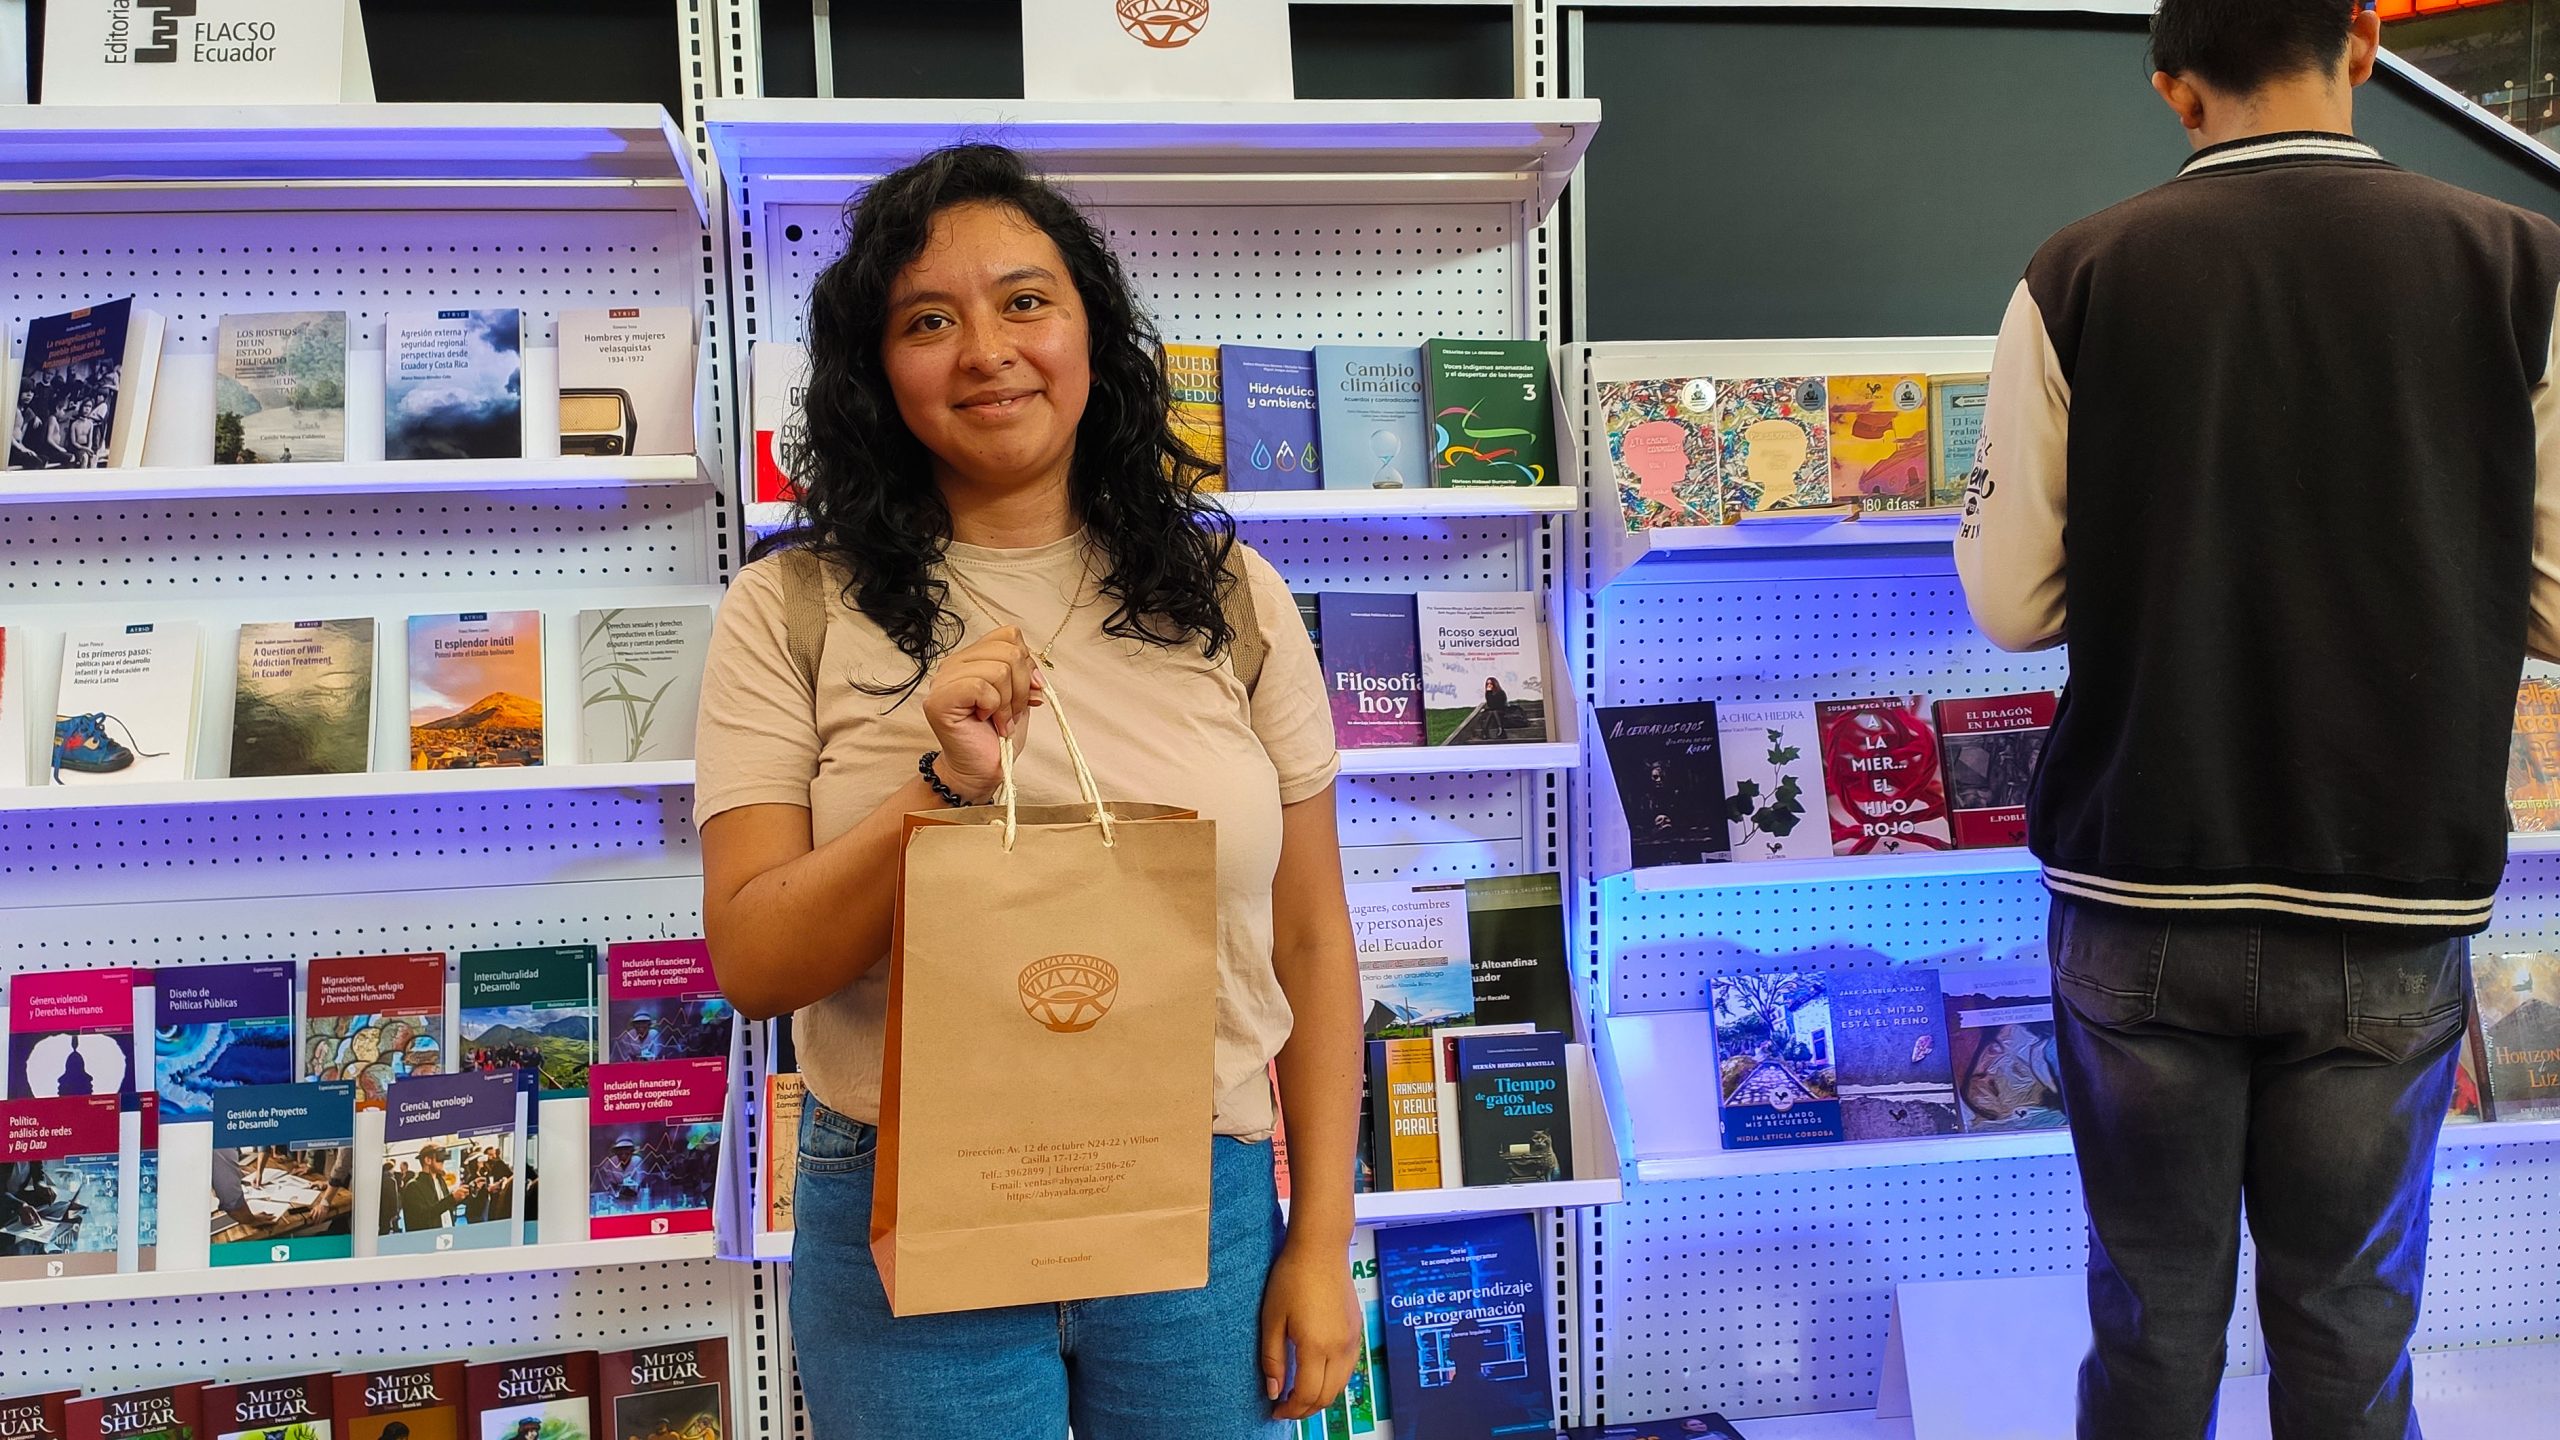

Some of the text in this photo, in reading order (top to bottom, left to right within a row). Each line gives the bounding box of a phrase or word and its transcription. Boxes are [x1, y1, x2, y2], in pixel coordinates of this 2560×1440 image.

[195, 22, 276, 42] FLACSO
[194, 42, 276, 63] Ecuador
[236, 328, 298, 339] LOS ROSTROS
[584, 331, 666, 344] Hombres y mujeres
[236, 339, 265, 348] DE UN
[401, 339, 436, 350] seguridad
[599, 343, 652, 355] velasquistas
[236, 348, 272, 357] ESTADO
[400, 349, 468, 361] perspectivas desde
[235, 357, 287, 367] DELEGADO
[400, 360, 469, 372] Ecuador y Costa Rica
[1345, 361, 1415, 377] Cambio
[1249, 382, 1316, 396] Hidráulica
[1340, 377, 1422, 393] climático
[1522, 383, 1537, 401] 3
[1862, 497, 1921, 512] 180 días:
[606, 621, 631, 630] Derechos
[631, 620, 654, 629] sexuales
[659, 620, 683, 628] derechos
[1438, 626, 1518, 638] Acoso sexual
[434, 635, 514, 651] El esplendor inútil
[1438, 636, 1520, 650] y universidad
[77, 648, 152, 661] Los primeros pasos:
[252, 656, 332, 668] Addiction Treatment
[73, 676, 119, 686] América Latina
[1357, 689, 1409, 719] hoy
[1966, 706, 2034, 720] EL DRAGÓN
[1867, 714, 1880, 729] A
[1967, 716, 2034, 731] EN LA FLOR
[1609, 720, 1705, 740] AL CERRAR LOS OJOS
[1864, 735, 1888, 750] LA
[1851, 756, 1908, 772] MIER...
[1872, 778, 1893, 793] EL
[1864, 799, 1907, 816] HILO
[1355, 914, 1444, 936] y personajes
[1358, 935, 1445, 953] del Ecuador
[473, 968, 540, 982] Interculturalidad
[621, 965, 705, 980] gestión de cooperativas
[321, 975, 366, 987] Migraciones
[321, 981, 404, 995] internacionales, refugio
[473, 981, 521, 995] y Desarrollo
[29, 993, 88, 1007] Género, violencia
[169, 987, 210, 999] Diseño de
[169, 998, 238, 1011] Políticas Públicas
[1847, 1004, 1925, 1018] EN LA MITAD
[1840, 1015, 1930, 1029] ESTÁ EL REINO
[603, 1078, 683, 1091] Inclusión financiera y
[1494, 1076, 1557, 1095] Tiempo
[603, 1087, 691, 1103] gestión de cooperativas
[1474, 1092, 1525, 1110] de gatos
[400, 1093, 474, 1113] Ciencia, tecnología
[1503, 1100, 1554, 1117] azules
[226, 1106, 308, 1120] Gestión de Proyectos
[1751, 1110, 1815, 1122] IMAGINANDO
[9, 1115, 40, 1127] Política,
[226, 1118, 279, 1131] de Desarrollo
[1395, 1116, 1439, 1137] PARALE
[1745, 1116, 1823, 1128] MIS RECUERDOS
[9, 1126, 73, 1139] análisis de redes
[957, 1146, 1005, 1158] Dirección:
[1006, 1145, 1021, 1154] Av.
[1023, 1143, 1035, 1153] 12
[1036, 1142, 1049, 1152] de
[1050, 1140, 1085, 1151] octubre
[1087, 1137, 1120, 1148] N24-22
[1129, 1135, 1160, 1146] Wilson
[1020, 1151, 1099, 1165] Casilla 17-12-719
[1005, 1166, 1045, 1178] 3962899
[1055, 1164, 1093, 1174] Librería:
[1095, 1159, 1137, 1172] 2506-267
[990, 1180, 1022, 1191] E-mail:
[1006, 1184, 1110, 1203] https://abyayala.org.ec/
[1030, 1252, 1093, 1268] Quito-Ecuador
[1420, 1259, 1429, 1267] Te
[1428, 1256, 1461, 1266] acompaño
[1465, 1252, 1499, 1263] programar
[1391, 1279, 1534, 1309] Guía de aprendizaje
[1402, 1300, 1526, 1327] de Programación
[641, 1350, 696, 1368] MITOS
[508, 1364, 565, 1382] MITOS
[630, 1362, 708, 1386] SHUAR
[375, 1372, 431, 1390] MITOS
[497, 1376, 577, 1400] SHUAR
[246, 1386, 304, 1404] MITOS
[363, 1384, 445, 1407] SHUAR
[111, 1396, 171, 1417] MITOS
[234, 1398, 319, 1423] SHUAR
[99, 1408, 186, 1435] SHUAR
